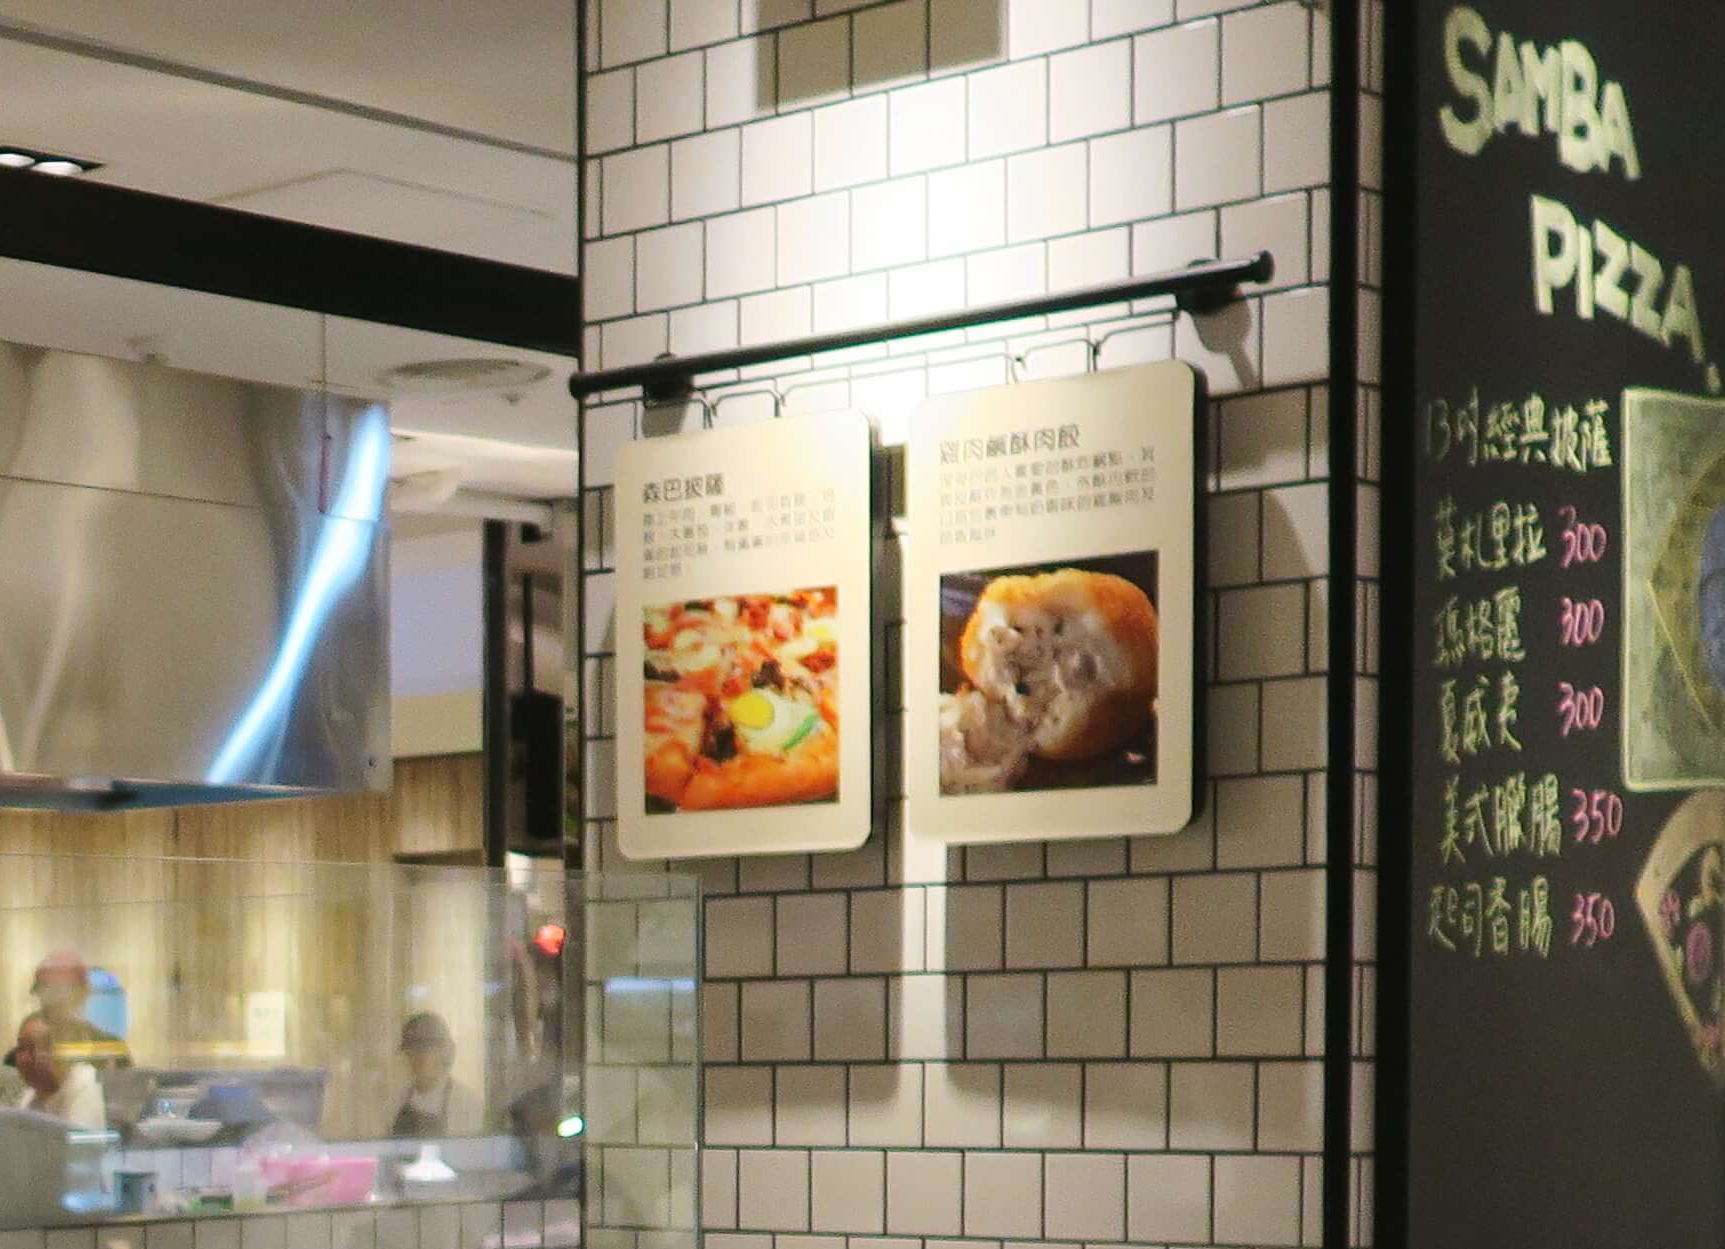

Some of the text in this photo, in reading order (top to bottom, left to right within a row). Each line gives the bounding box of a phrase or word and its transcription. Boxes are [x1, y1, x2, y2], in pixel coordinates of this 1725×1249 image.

[1439, 7, 1643, 181] SAMBA
[1531, 194, 1706, 364] PIZZA
[1559, 597, 1605, 647] 300
[1556, 681, 1604, 737] 300
[1571, 788, 1624, 845] 350
[1570, 892, 1616, 947] 350
